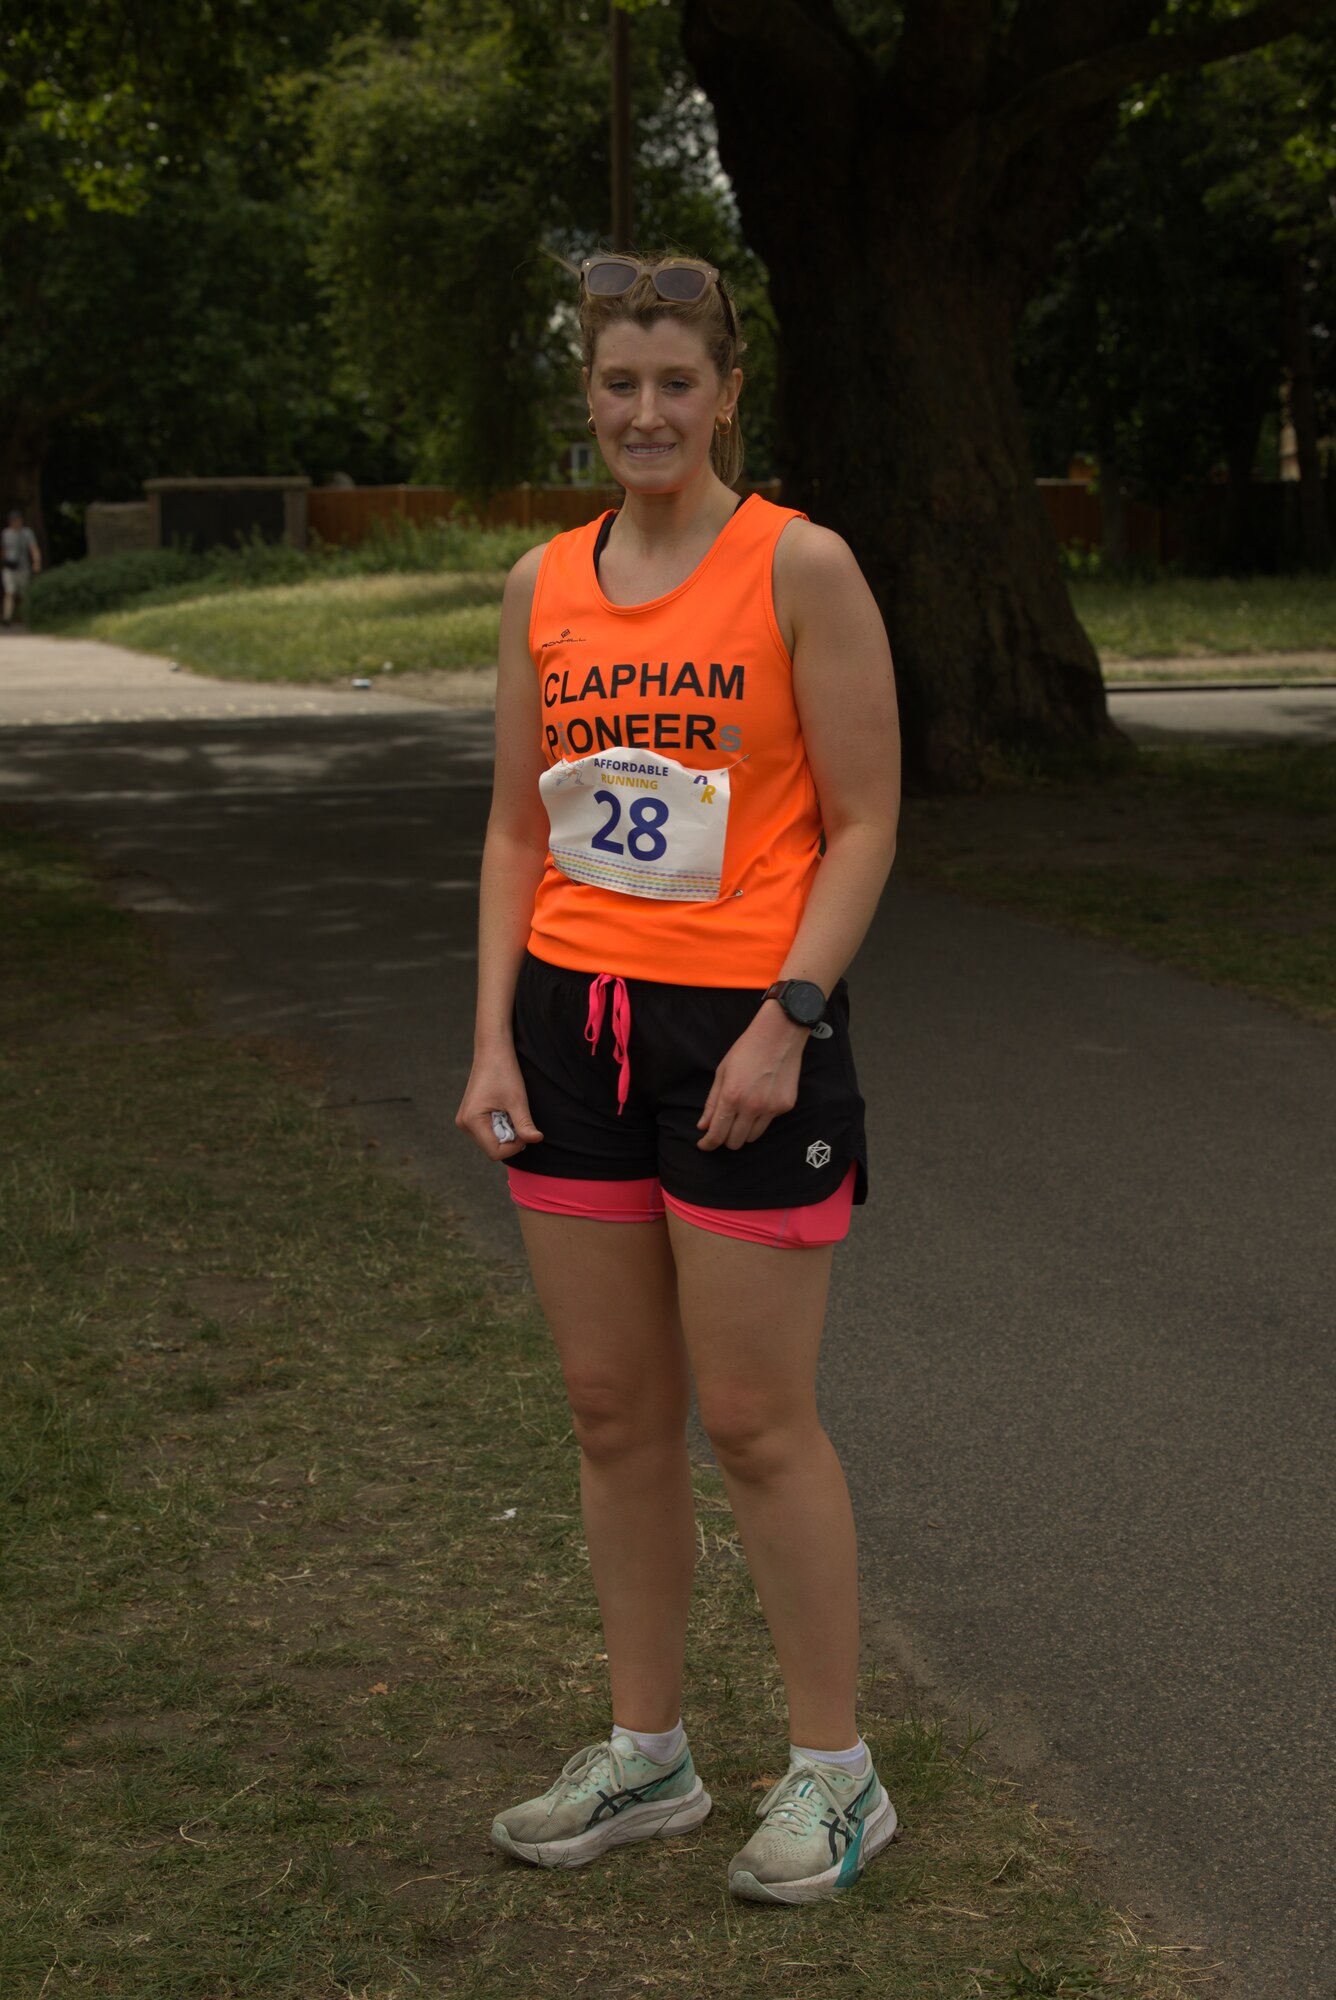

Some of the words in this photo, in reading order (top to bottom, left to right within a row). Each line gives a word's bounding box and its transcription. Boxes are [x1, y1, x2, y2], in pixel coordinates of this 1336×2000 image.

[544, 662, 745, 708] CLAPHAM
[594, 758, 669, 776] AFFORDABLE
[601, 773, 659, 790] RUNNING
[591, 789, 669, 862] 28
